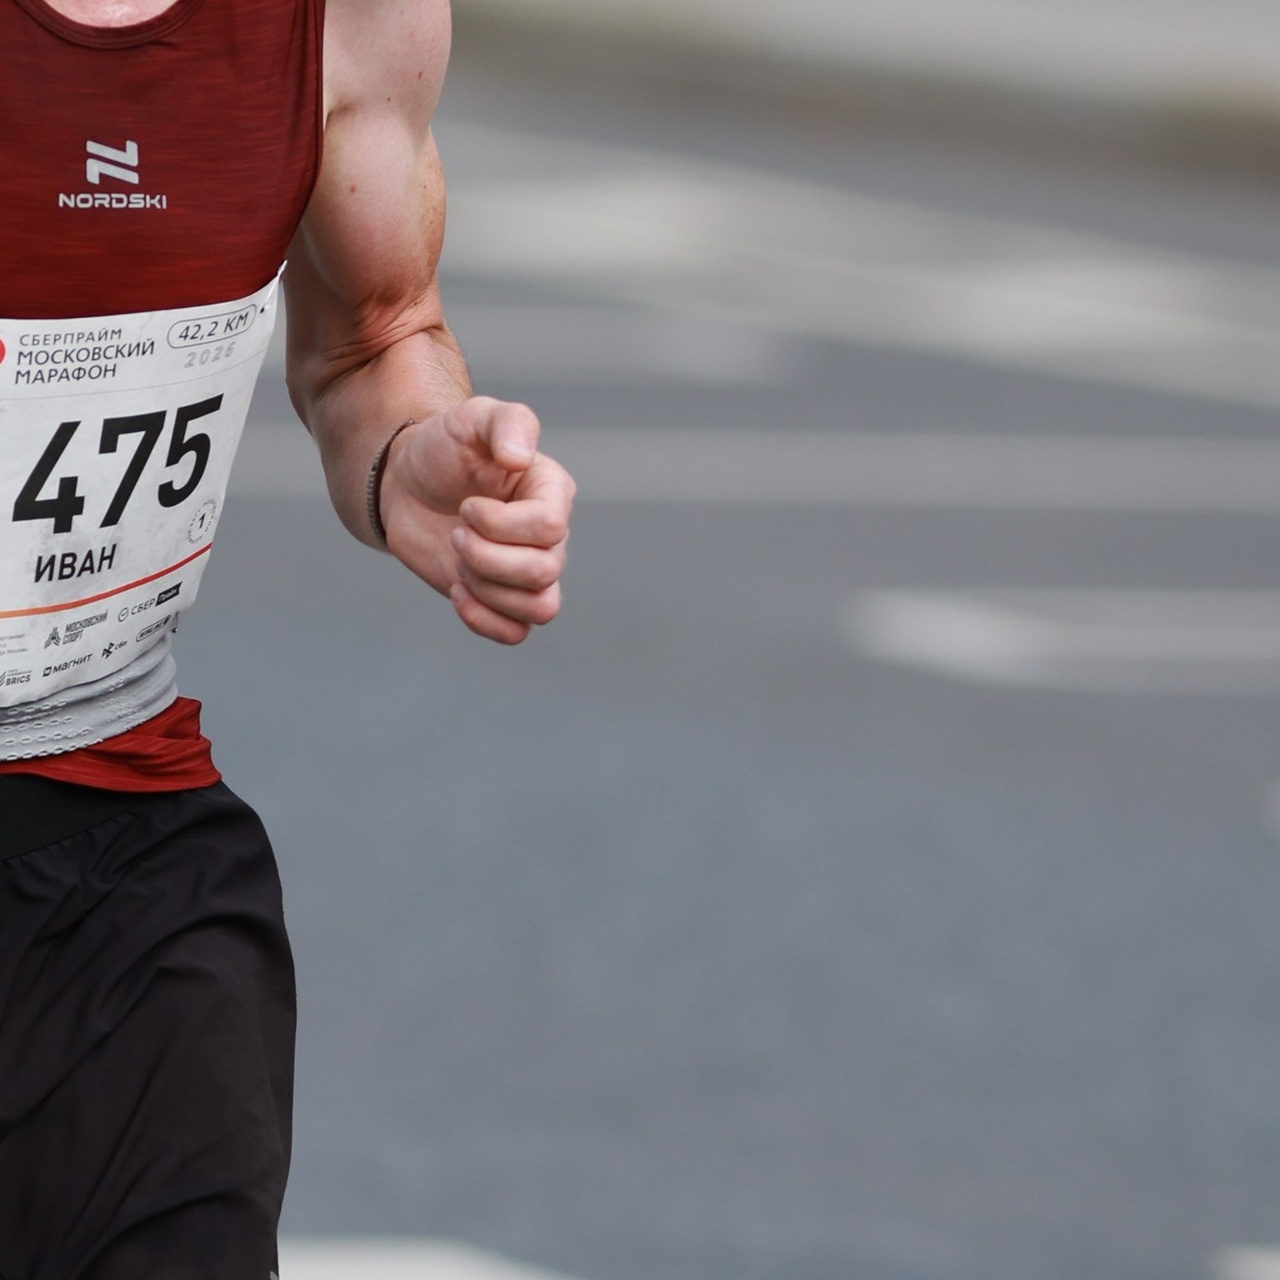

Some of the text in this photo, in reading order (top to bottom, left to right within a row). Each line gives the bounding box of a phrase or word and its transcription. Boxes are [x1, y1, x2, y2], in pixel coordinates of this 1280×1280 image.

[58, 192, 167, 209] NORDSKI
[19, 328, 122, 347] СБЕРПРАЙМ
[178, 321, 219, 342] 42,2
[17, 337, 155, 366] МОСКОВСКИЙ
[184, 341, 236, 368] 2026
[14, 363, 117, 385] МАРАФОН
[34, 543, 117, 583] ИВАН
[131, 597, 155, 615] СБЕР
[65, 609, 108, 634] МОСКОВСКИЙ
[62, 629, 84, 645] СПОРТ
[5, 674, 31, 686] BRICS
